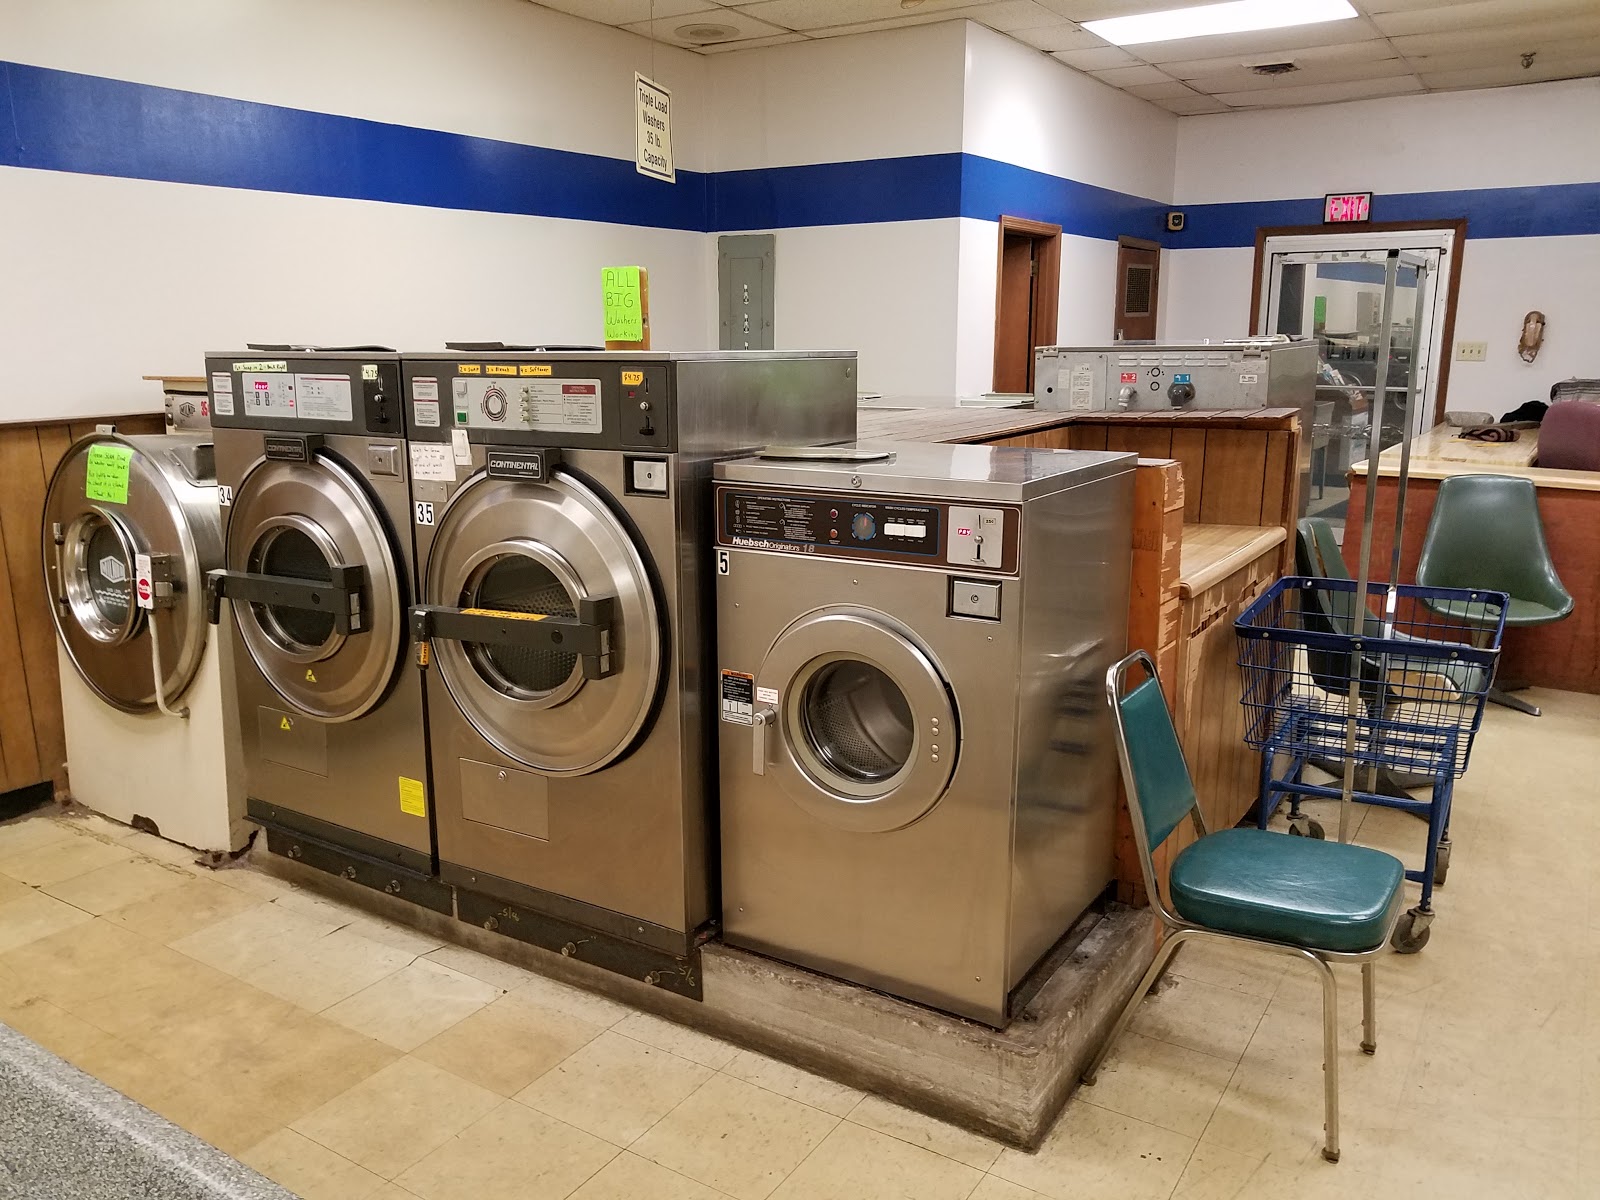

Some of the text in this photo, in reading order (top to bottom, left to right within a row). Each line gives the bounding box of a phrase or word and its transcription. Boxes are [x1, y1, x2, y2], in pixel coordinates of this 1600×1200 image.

[639, 88, 668, 114] Triple Load
[643, 110, 665, 131] Washers
[647, 131, 653, 145] 35
[644, 149, 667, 171] Capacity
[1330, 196, 1365, 221] EXIT
[606, 271, 635, 287] ALL
[606, 292, 633, 307] BIG
[607, 310, 637, 325] Washers
[607, 329, 637, 339] Working
[624, 373, 640, 381] $4.75
[490, 460, 538, 470] CONTINENTAL
[220, 487, 231, 504] 34
[418, 504, 432, 523] 35
[720, 551, 728, 573] 5
